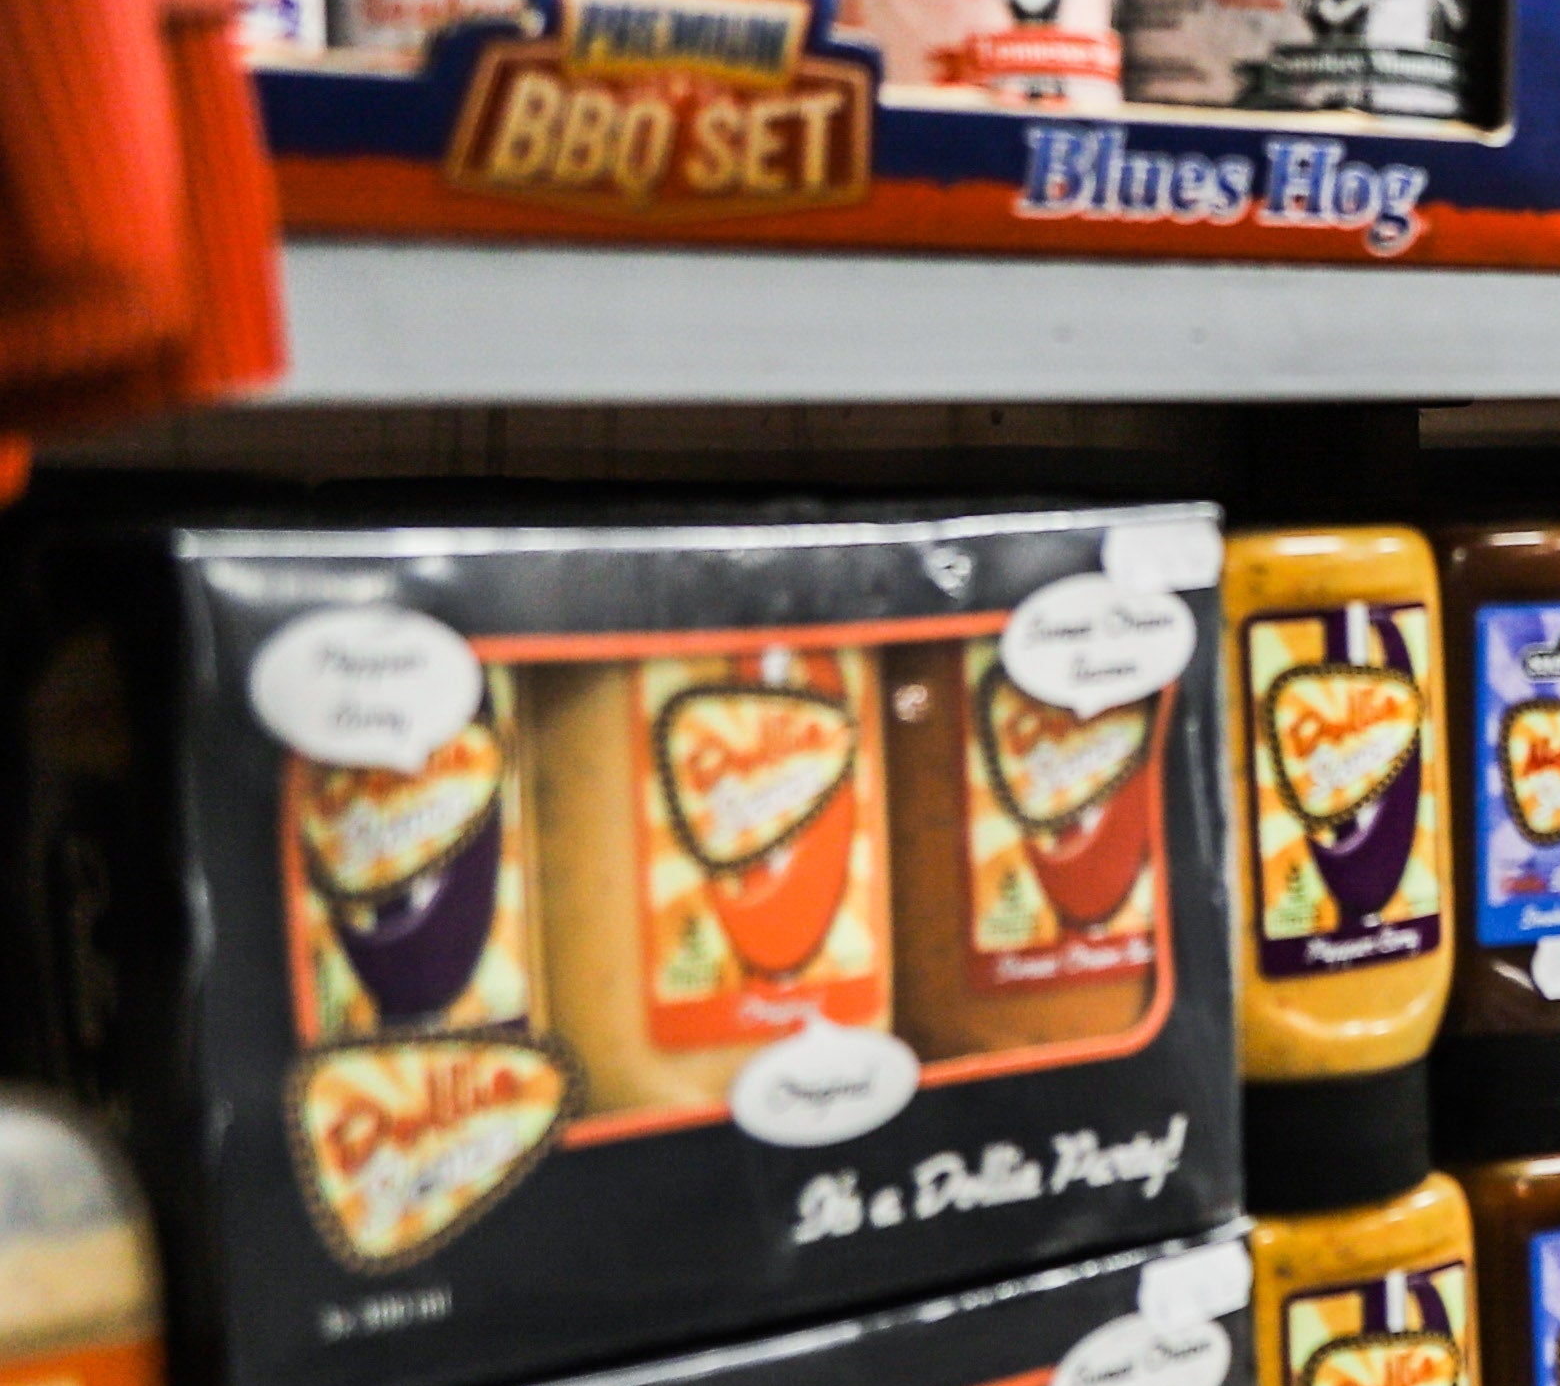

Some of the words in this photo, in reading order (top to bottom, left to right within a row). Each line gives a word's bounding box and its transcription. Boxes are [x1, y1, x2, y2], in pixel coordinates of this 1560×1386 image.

[573, 0, 795, 69] PREMIUM
[492, 73, 665, 201] BBQ
[689, 87, 841, 191] SET
[1018, 124, 1254, 222] Blues
[1260, 135, 1428, 256] Hog
